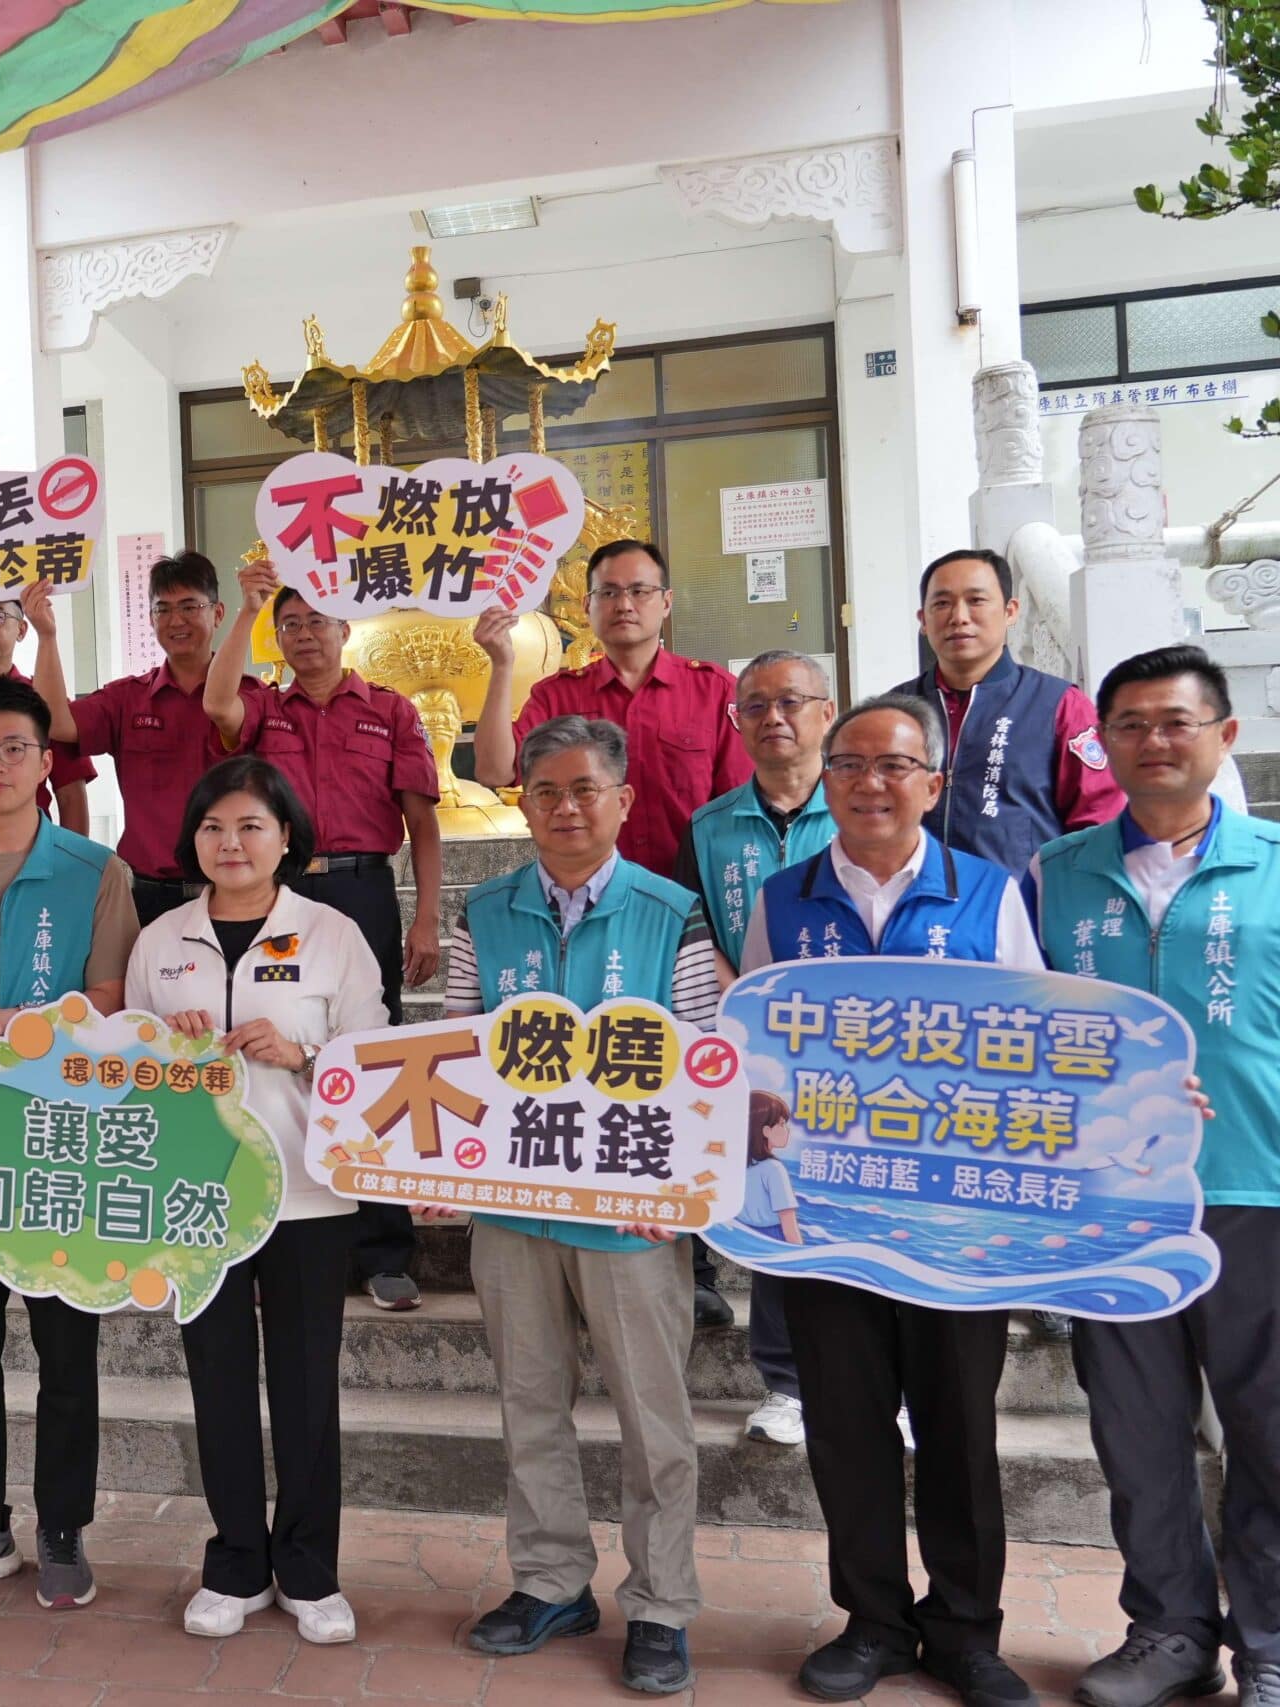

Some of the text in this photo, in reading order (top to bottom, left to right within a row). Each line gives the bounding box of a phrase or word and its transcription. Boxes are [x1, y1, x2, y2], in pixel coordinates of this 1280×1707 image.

[271, 474, 514, 563] 不 燃放
[350, 543, 485, 603] 爆竹
[981, 717, 1013, 817] 雲林縣消防局
[743, 843, 760, 877] 秘書
[31, 907, 53, 1005] 土庫鎮公
[1101, 897, 1127, 937] 助理
[1203, 890, 1237, 1027] 土庫鎮公所
[62, 1057, 233, 1094] 環保自然葬
[766, 991, 1116, 1079] 中彰投苗雲
[353, 1008, 665, 1158] 不 燃燒
[793, 1070, 1077, 1156] 聯合海葬
[24, 1099, 158, 1170] 讓愛
[507, 1096, 674, 1180] 紙錢
